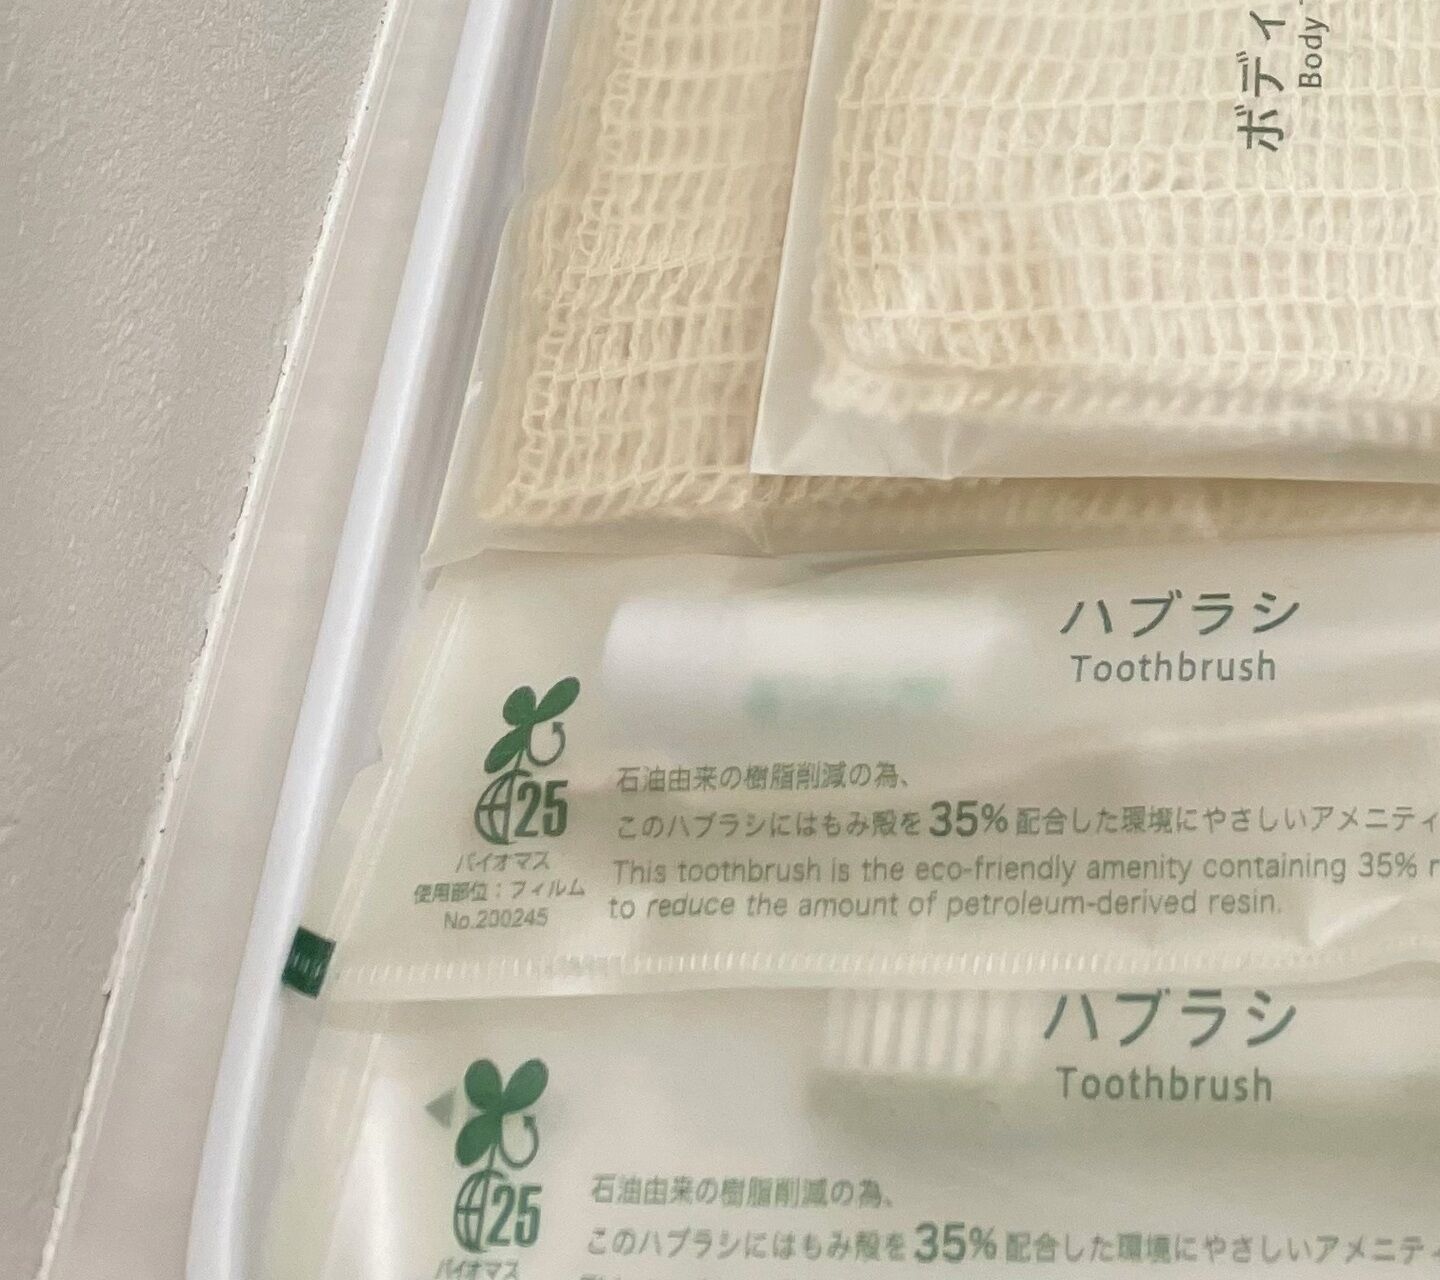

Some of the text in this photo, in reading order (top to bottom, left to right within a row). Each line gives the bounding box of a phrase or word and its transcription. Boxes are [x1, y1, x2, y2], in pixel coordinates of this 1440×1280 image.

[1297, 15, 1330, 89] Body
[1059, 588, 1300, 638] ハブラシ
[1069, 648, 1276, 683] Toothbrush
[514, 779, 569, 838] 25
[454, 850, 551, 874] バイオマス
[612, 859, 667, 885] This
[677, 855, 822, 883] toothbrush
[831, 856, 850, 882] is
[862, 856, 905, 882] the
[915, 854, 1077, 887] eco-friendly
[1086, 852, 1193, 886] amenity
[1202, 852, 1347, 884] containing
[1357, 851, 1418, 879] 35%
[607, 897, 636, 919] to
[646, 892, 736, 918] reduce
[747, 892, 789, 917] the
[798, 893, 900, 918] amount
[908, 890, 939, 915] of
[945, 888, 1198, 923] petroleum-derived
[1042, 987, 1297, 1048] ハブラシ
[1055, 1064, 1273, 1102] Toothbrush
[484, 1183, 543, 1249] 25
